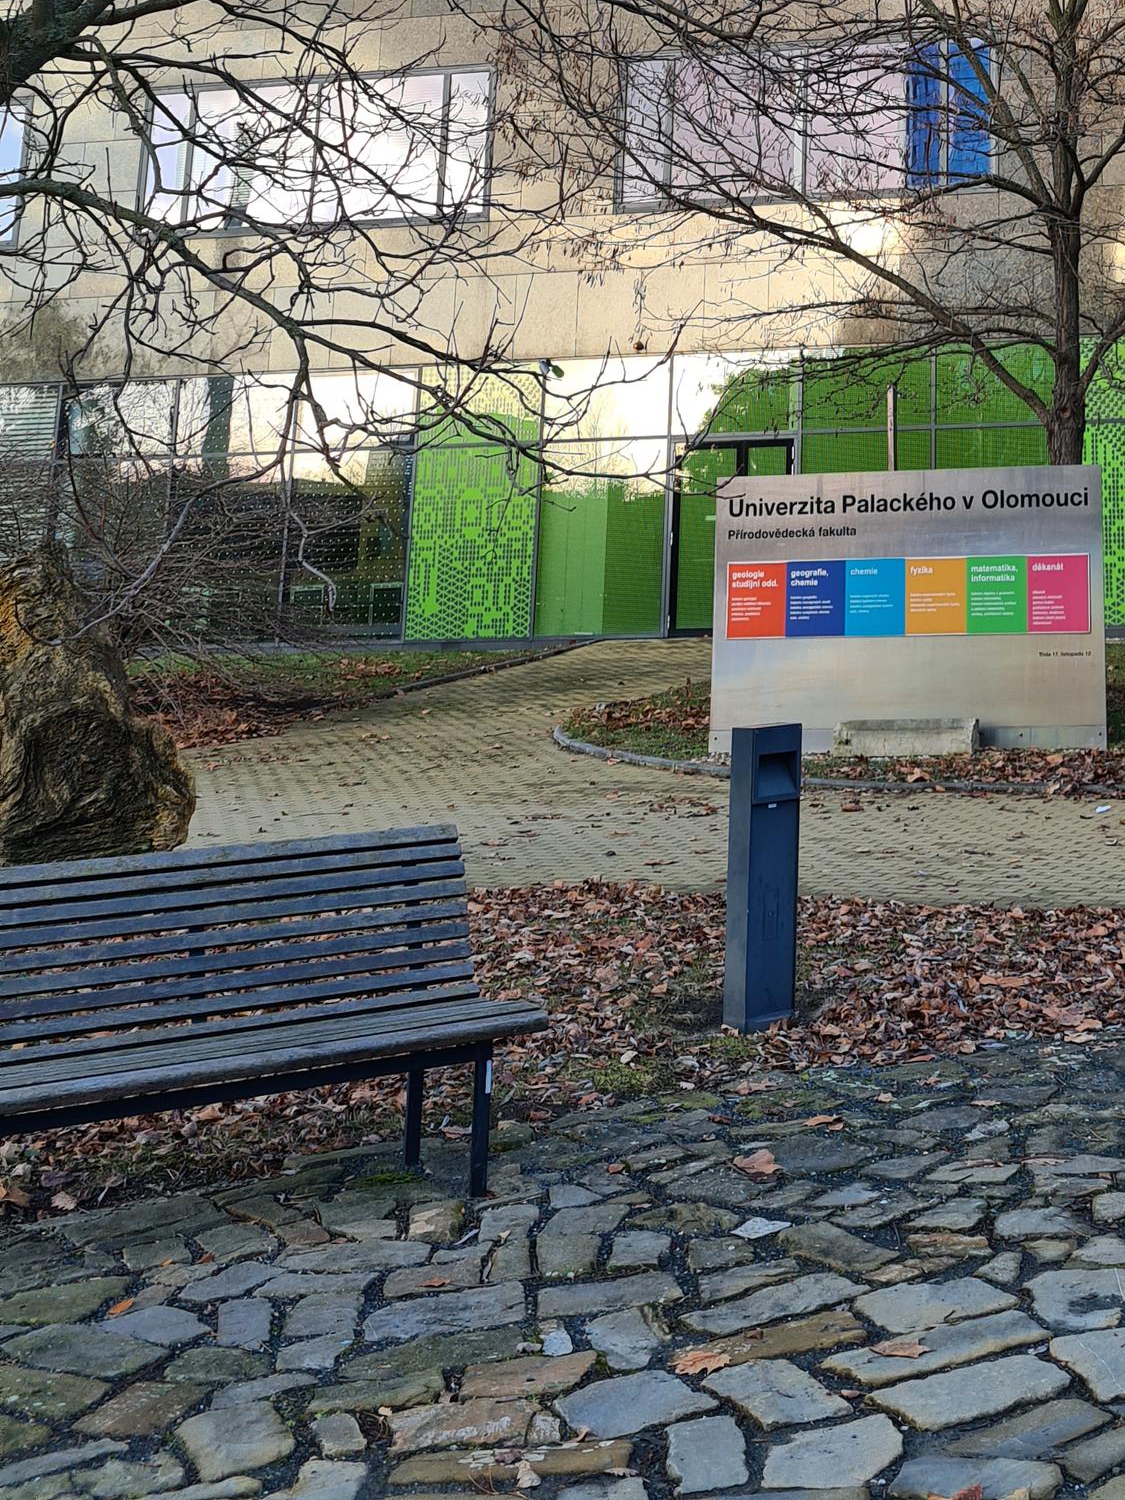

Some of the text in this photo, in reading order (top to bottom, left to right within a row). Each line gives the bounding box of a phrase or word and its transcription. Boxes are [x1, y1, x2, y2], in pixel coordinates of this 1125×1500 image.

[729, 487, 1089, 518] Univerzita Palackého v Olomouci
[728, 526, 857, 540] Přírodovědecká fakulta
[850, 566, 878, 576] chemie
[910, 565, 933, 576] fyzika
[971, 563, 1018, 573] matematika,
[1032, 561, 1064, 572] děkanát
[732, 570, 765, 580] geologie
[790, 568, 829, 579] geografie,
[971, 572, 1015, 582] informatika
[761, 579, 779, 588] odd.
[790, 578, 818, 587] chemie
